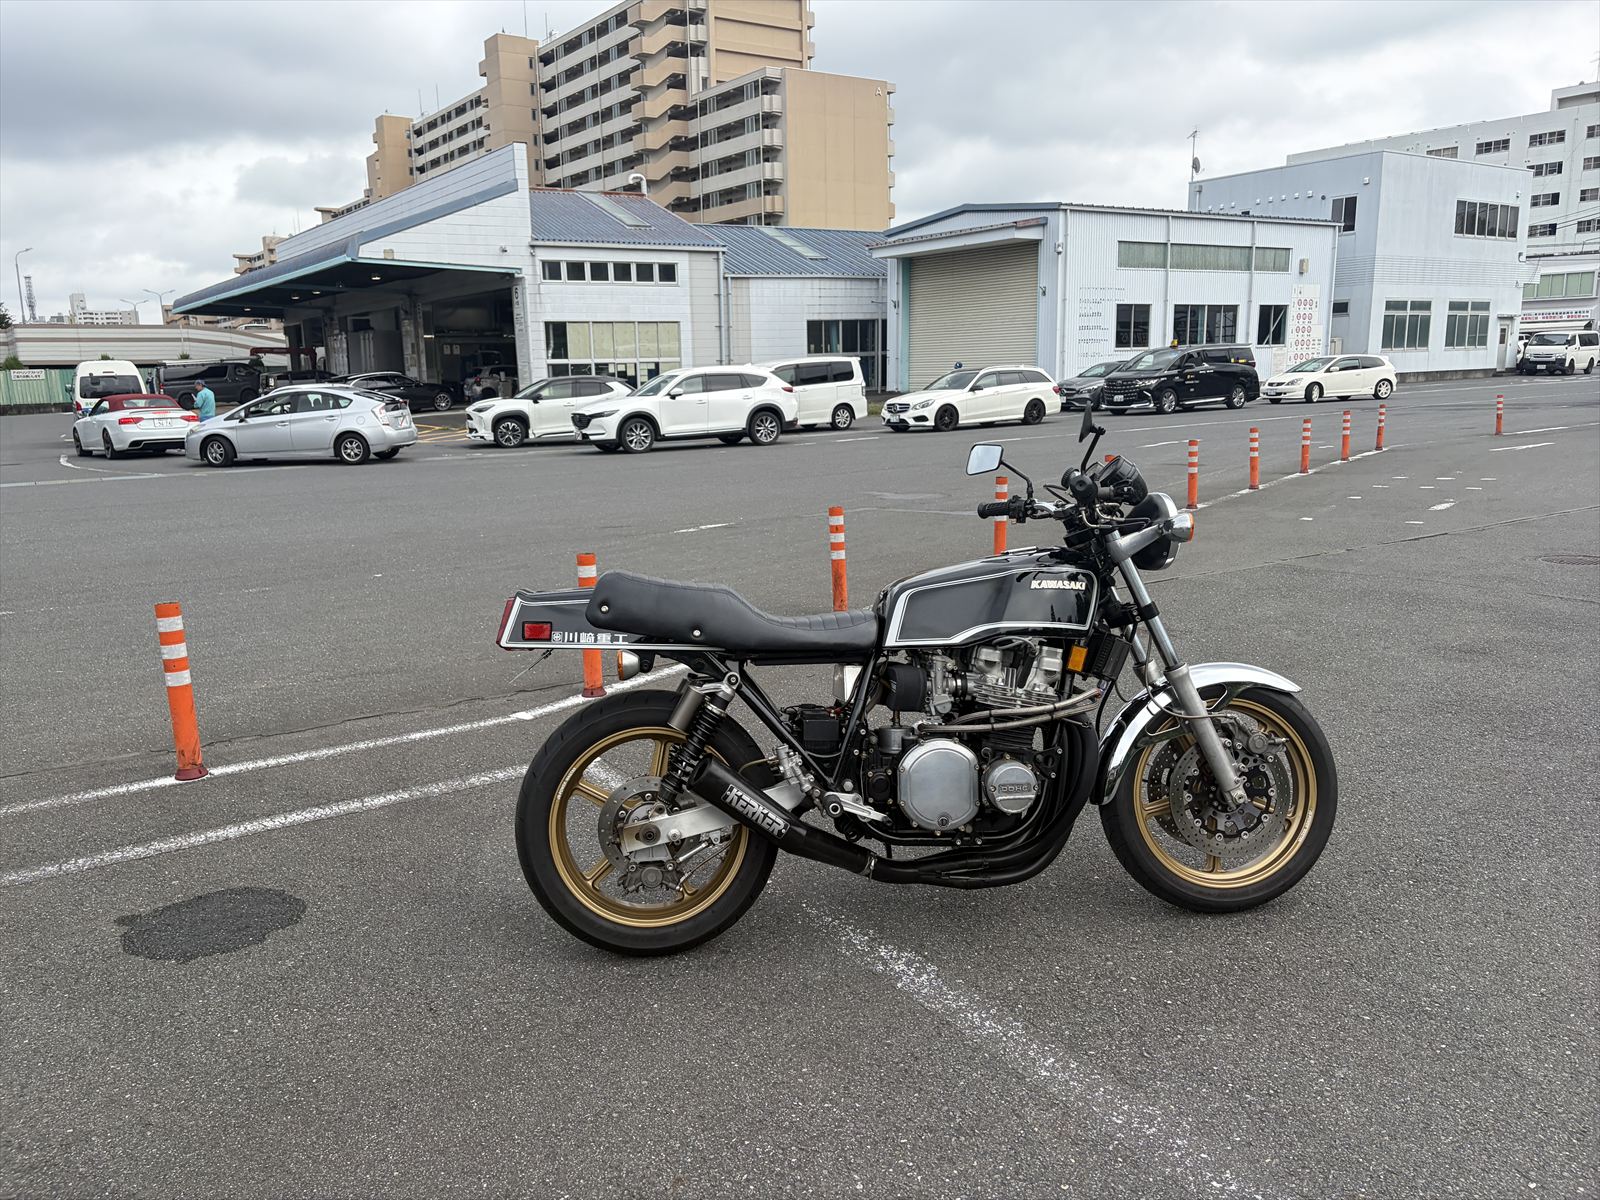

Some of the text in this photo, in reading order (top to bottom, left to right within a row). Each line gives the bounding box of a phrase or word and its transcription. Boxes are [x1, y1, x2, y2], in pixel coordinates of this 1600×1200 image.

[875, 86, 882, 96] A
[514, 288, 519, 300] 6
[1030, 580, 1086, 590] KAWASAKI
[564, 632, 628, 644] 川崎重工
[726, 787, 785, 836] KERKER
